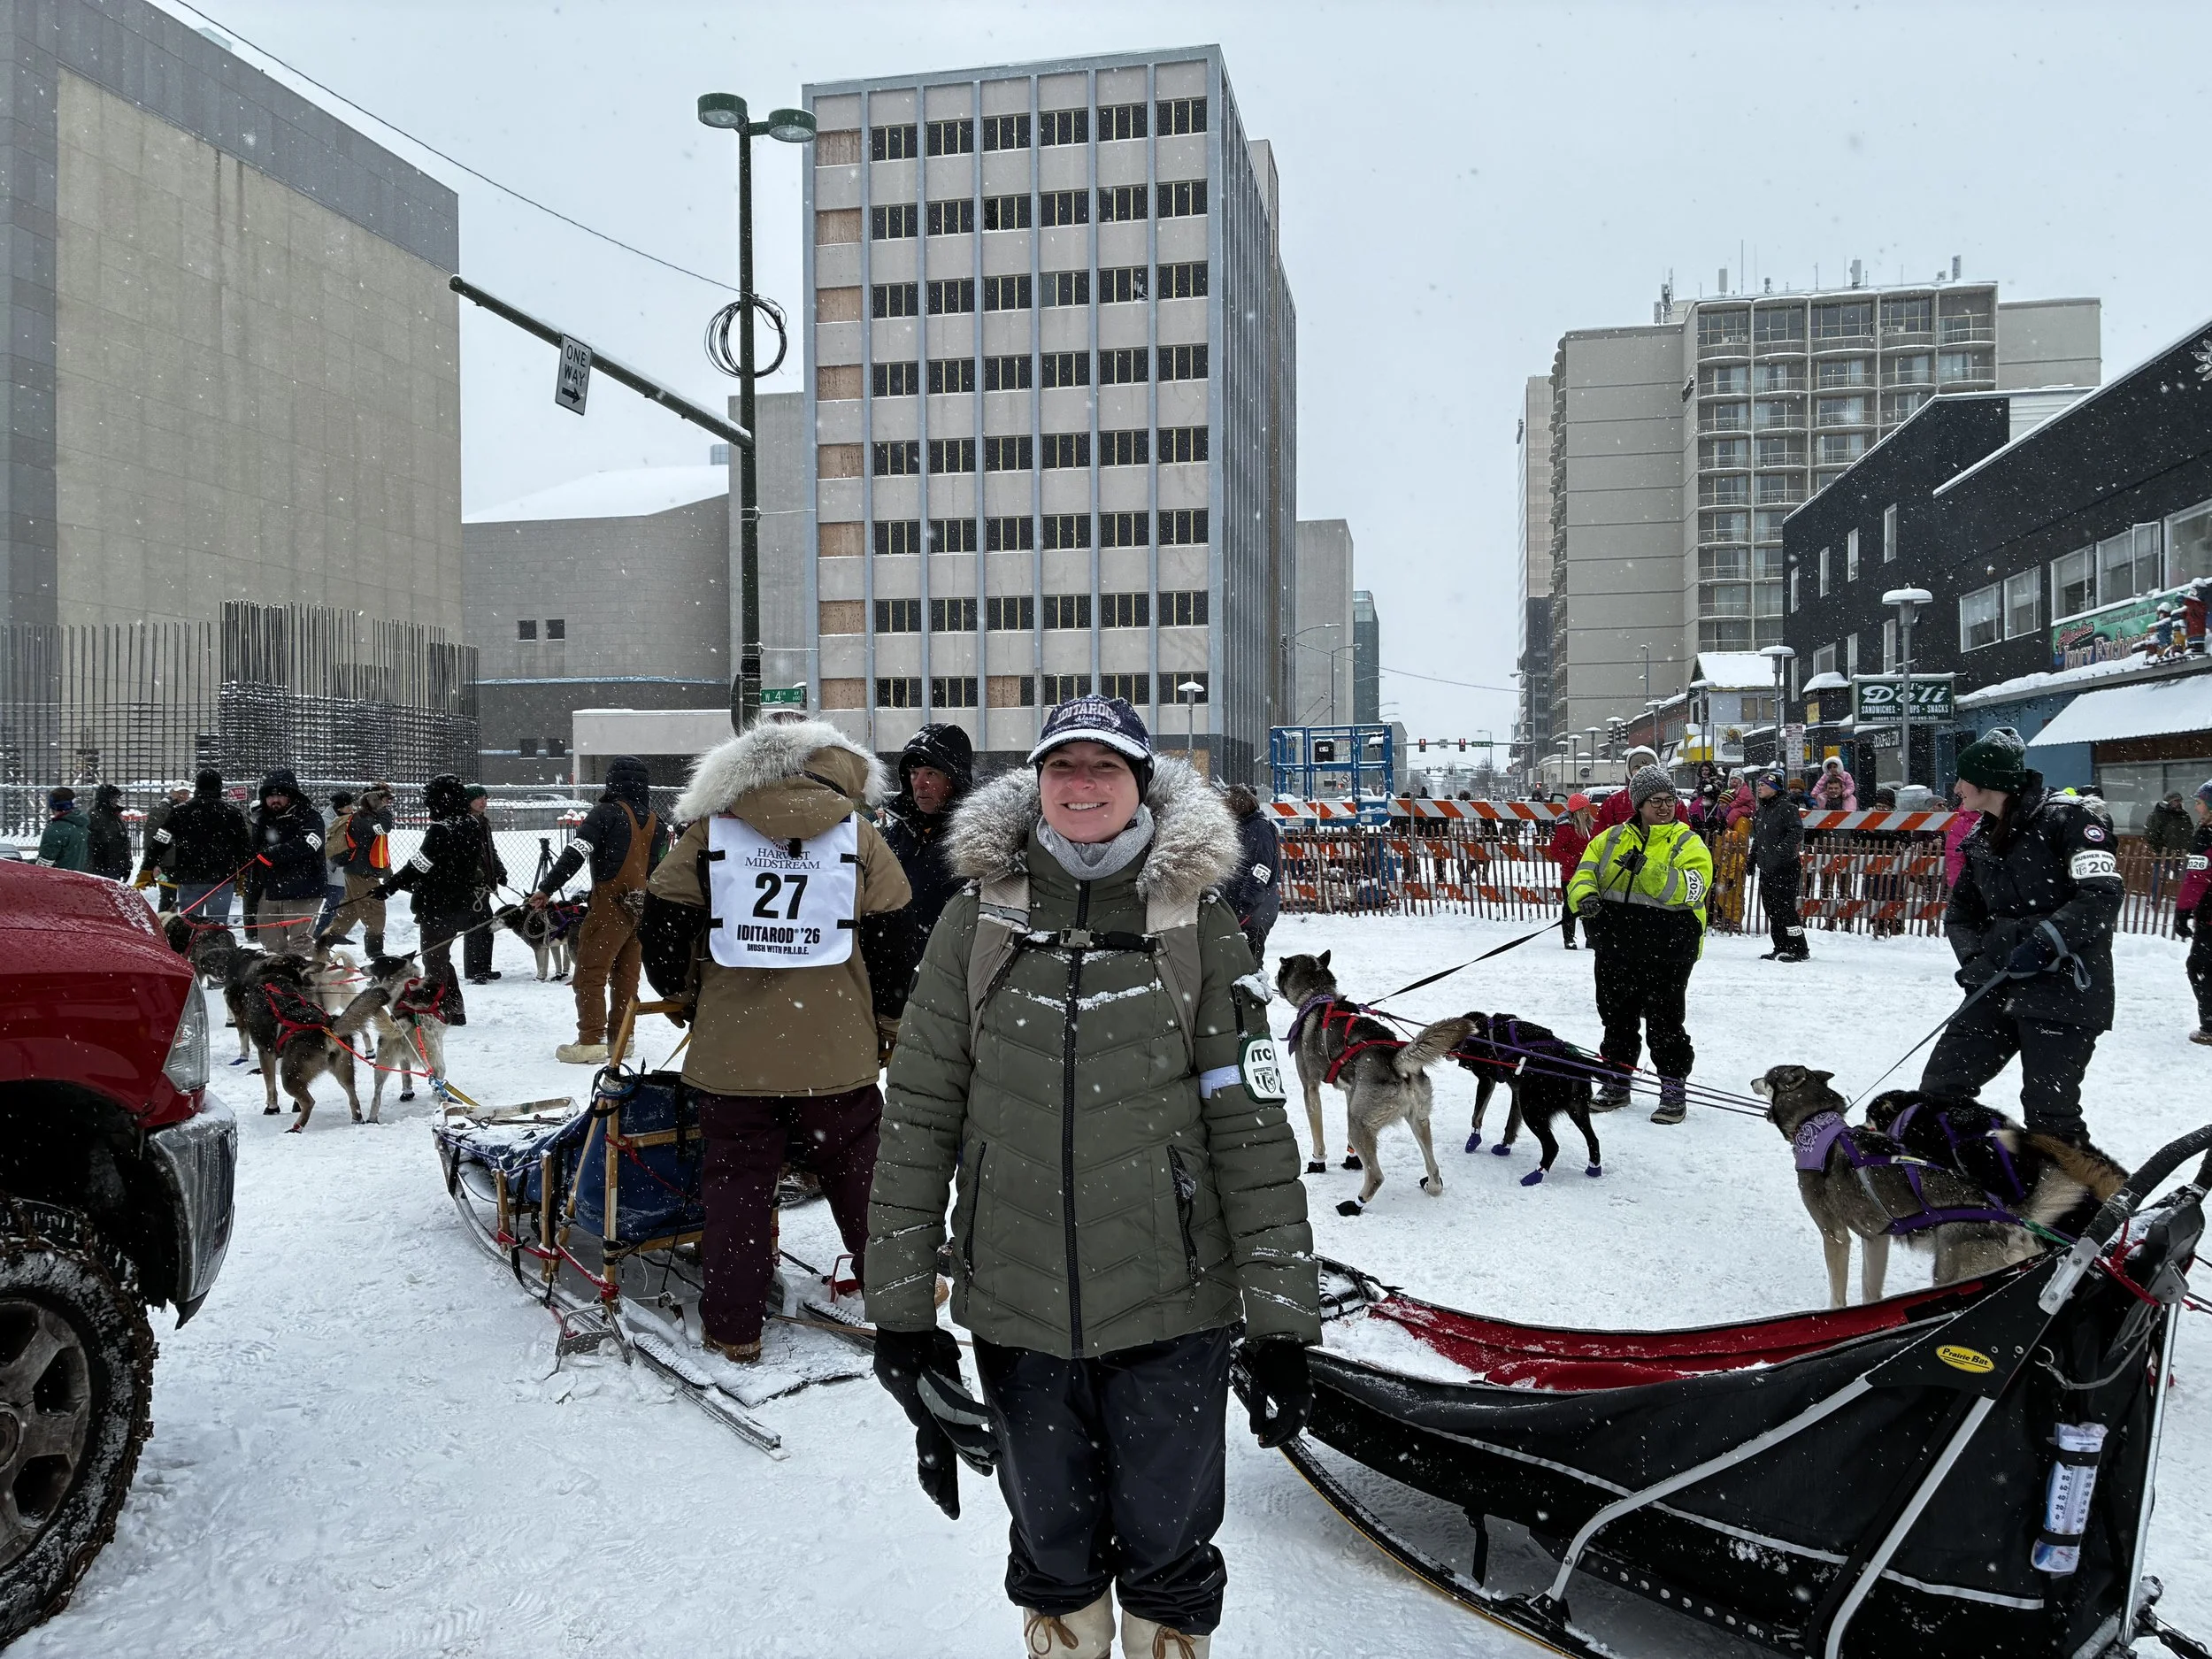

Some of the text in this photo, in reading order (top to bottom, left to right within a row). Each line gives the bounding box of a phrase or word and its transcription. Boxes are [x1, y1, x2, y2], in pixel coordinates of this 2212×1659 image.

[566, 344, 587, 367] ONE
[564, 363, 585, 386] WAY
[764, 693, 771, 702] W
[1862, 686, 1947, 703] Deli
[1055, 702, 1117, 725] IDITAROD
[1861, 704, 1949, 715] SANDWICHES UPS SNACKS
[744, 856, 821, 870] MIDSTREAM
[752, 872, 809, 920] 27
[800, 928, 821, 944] '26
[747, 943, 810, 955] MUSH WITH P.R.I.D.E.
[1251, 1048, 1272, 1063] ITC
[1942, 1348, 1971, 1362] Prairie
